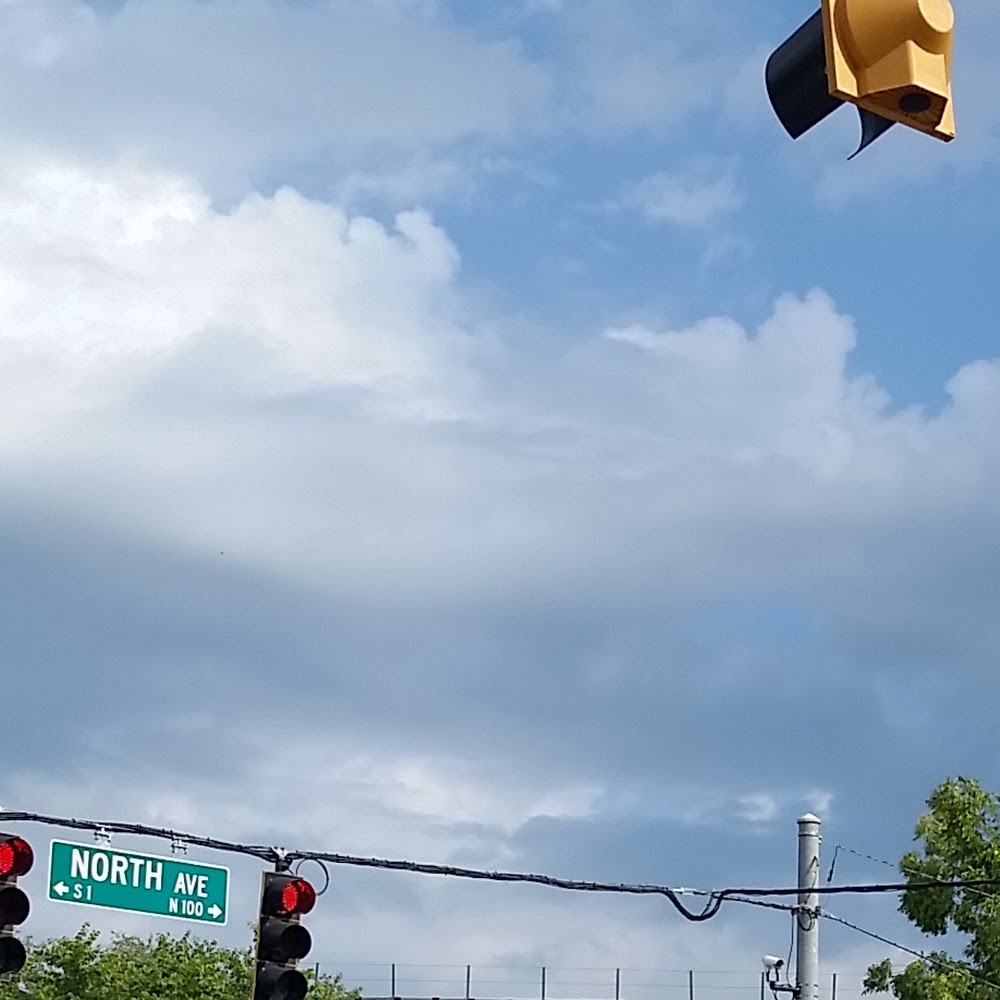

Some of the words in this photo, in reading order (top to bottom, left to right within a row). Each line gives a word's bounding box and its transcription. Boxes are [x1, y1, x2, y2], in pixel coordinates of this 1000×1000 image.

[70, 848, 163, 891] NORTH
[174, 872, 209, 898] AVE
[73, 883, 83, 899] S
[169, 898, 179, 913] N
[182, 900, 204, 917] 100
